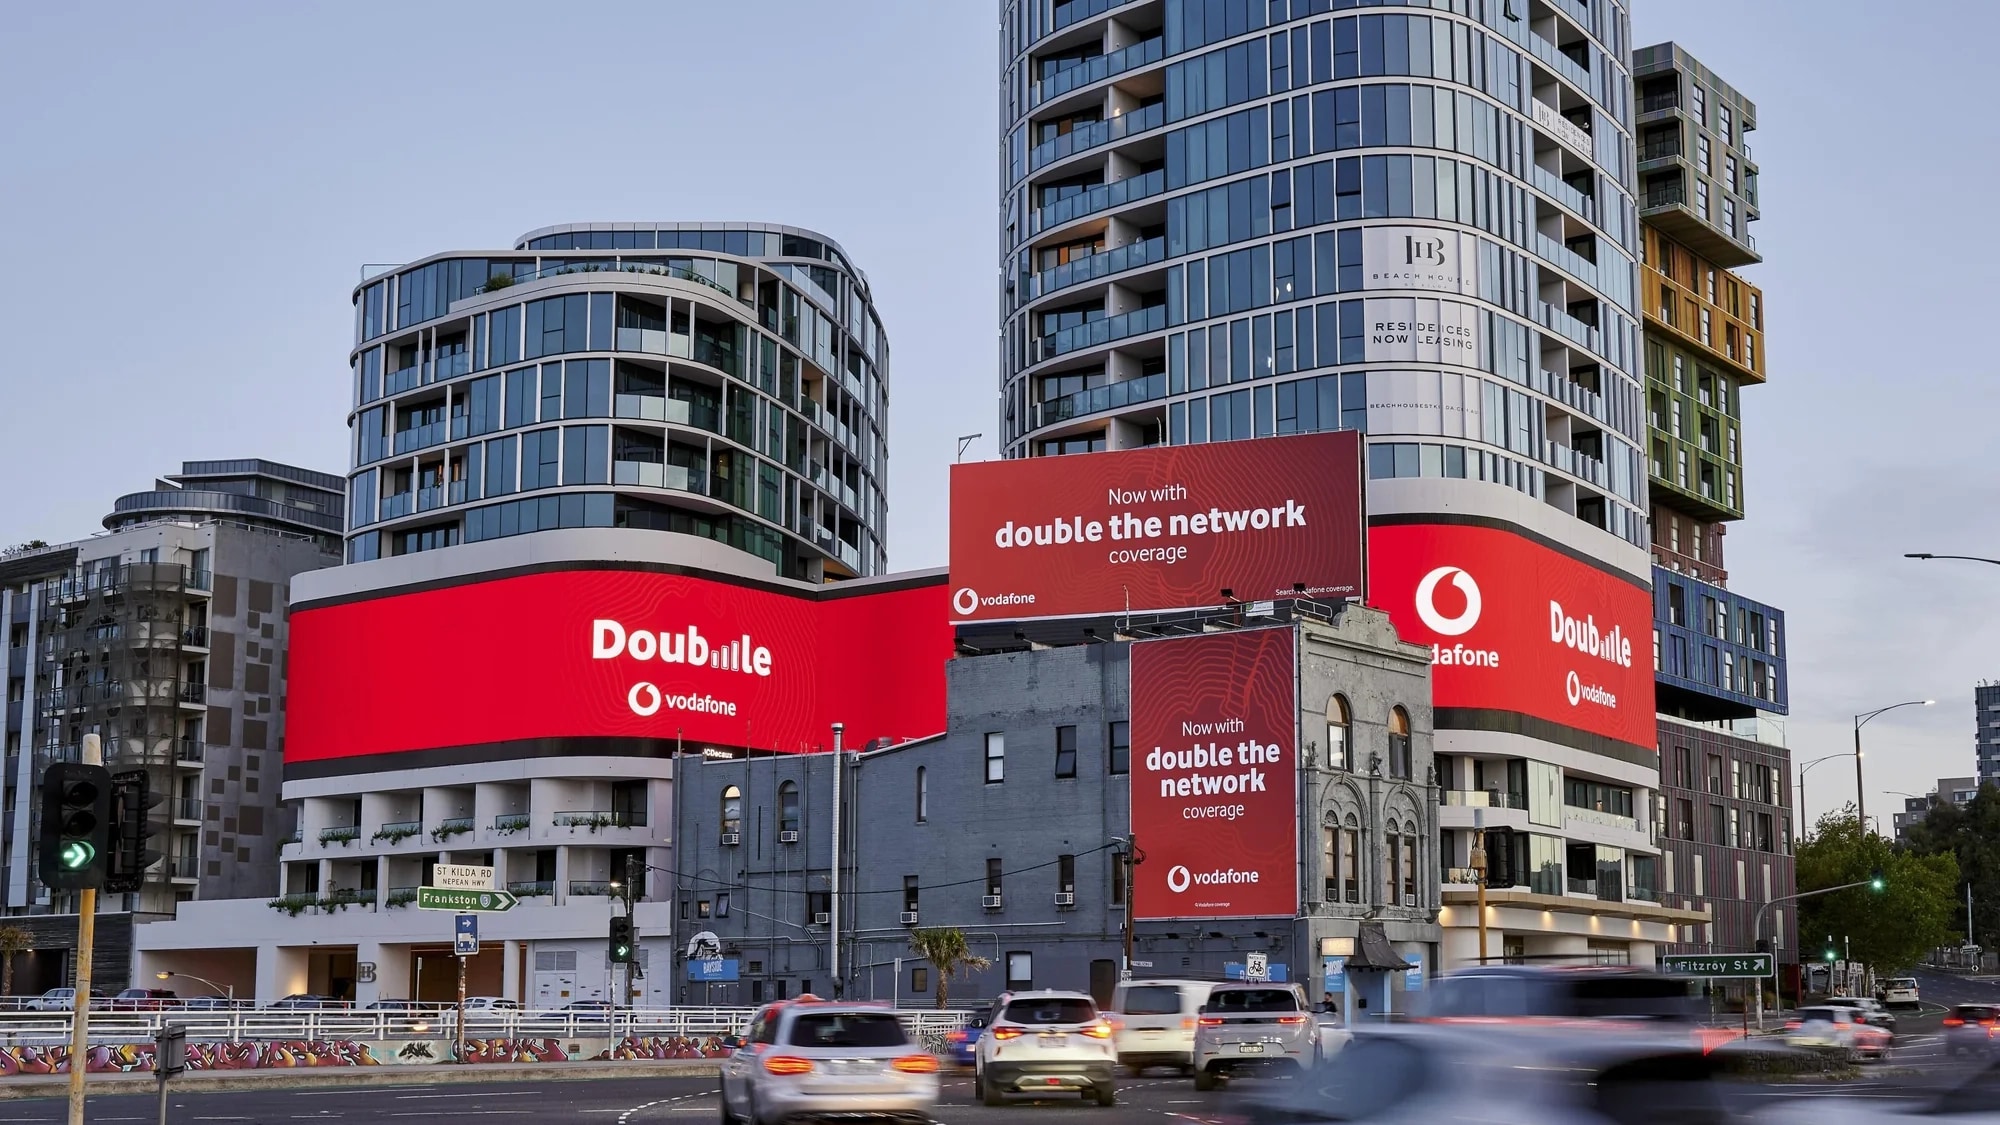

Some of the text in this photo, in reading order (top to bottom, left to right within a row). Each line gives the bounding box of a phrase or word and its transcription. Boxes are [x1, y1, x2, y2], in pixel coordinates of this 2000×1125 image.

[1428, 273, 1470, 286] HOUSE
[1373, 335, 1473, 350] NOW LEASING
[1108, 483, 1187, 506] Now with
[994, 499, 1307, 549] double the network
[1108, 544, 1187, 564] coverage
[980, 592, 1035, 606] vodafone
[1275, 587, 1296, 597] Search
[1325, 585, 1355, 593] coverage.
[1431, 643, 1500, 668] dafone
[665, 692, 737, 717] vodafone
[1580, 684, 1616, 709] vodafone
[1182, 717, 1244, 737] Now with
[1146, 739, 1281, 771] double the
[1160, 767, 1267, 798] network
[1183, 803, 1245, 821] coverage
[437, 866, 492, 878] ST KILDA RD
[1193, 868, 1259, 885] vodafone
[442, 878, 486, 887] NEPEAN HWY
[423, 893, 477, 905] Frankston
[1680, 960, 1727, 973] Fitzroy
[1734, 960, 1748, 971] St
